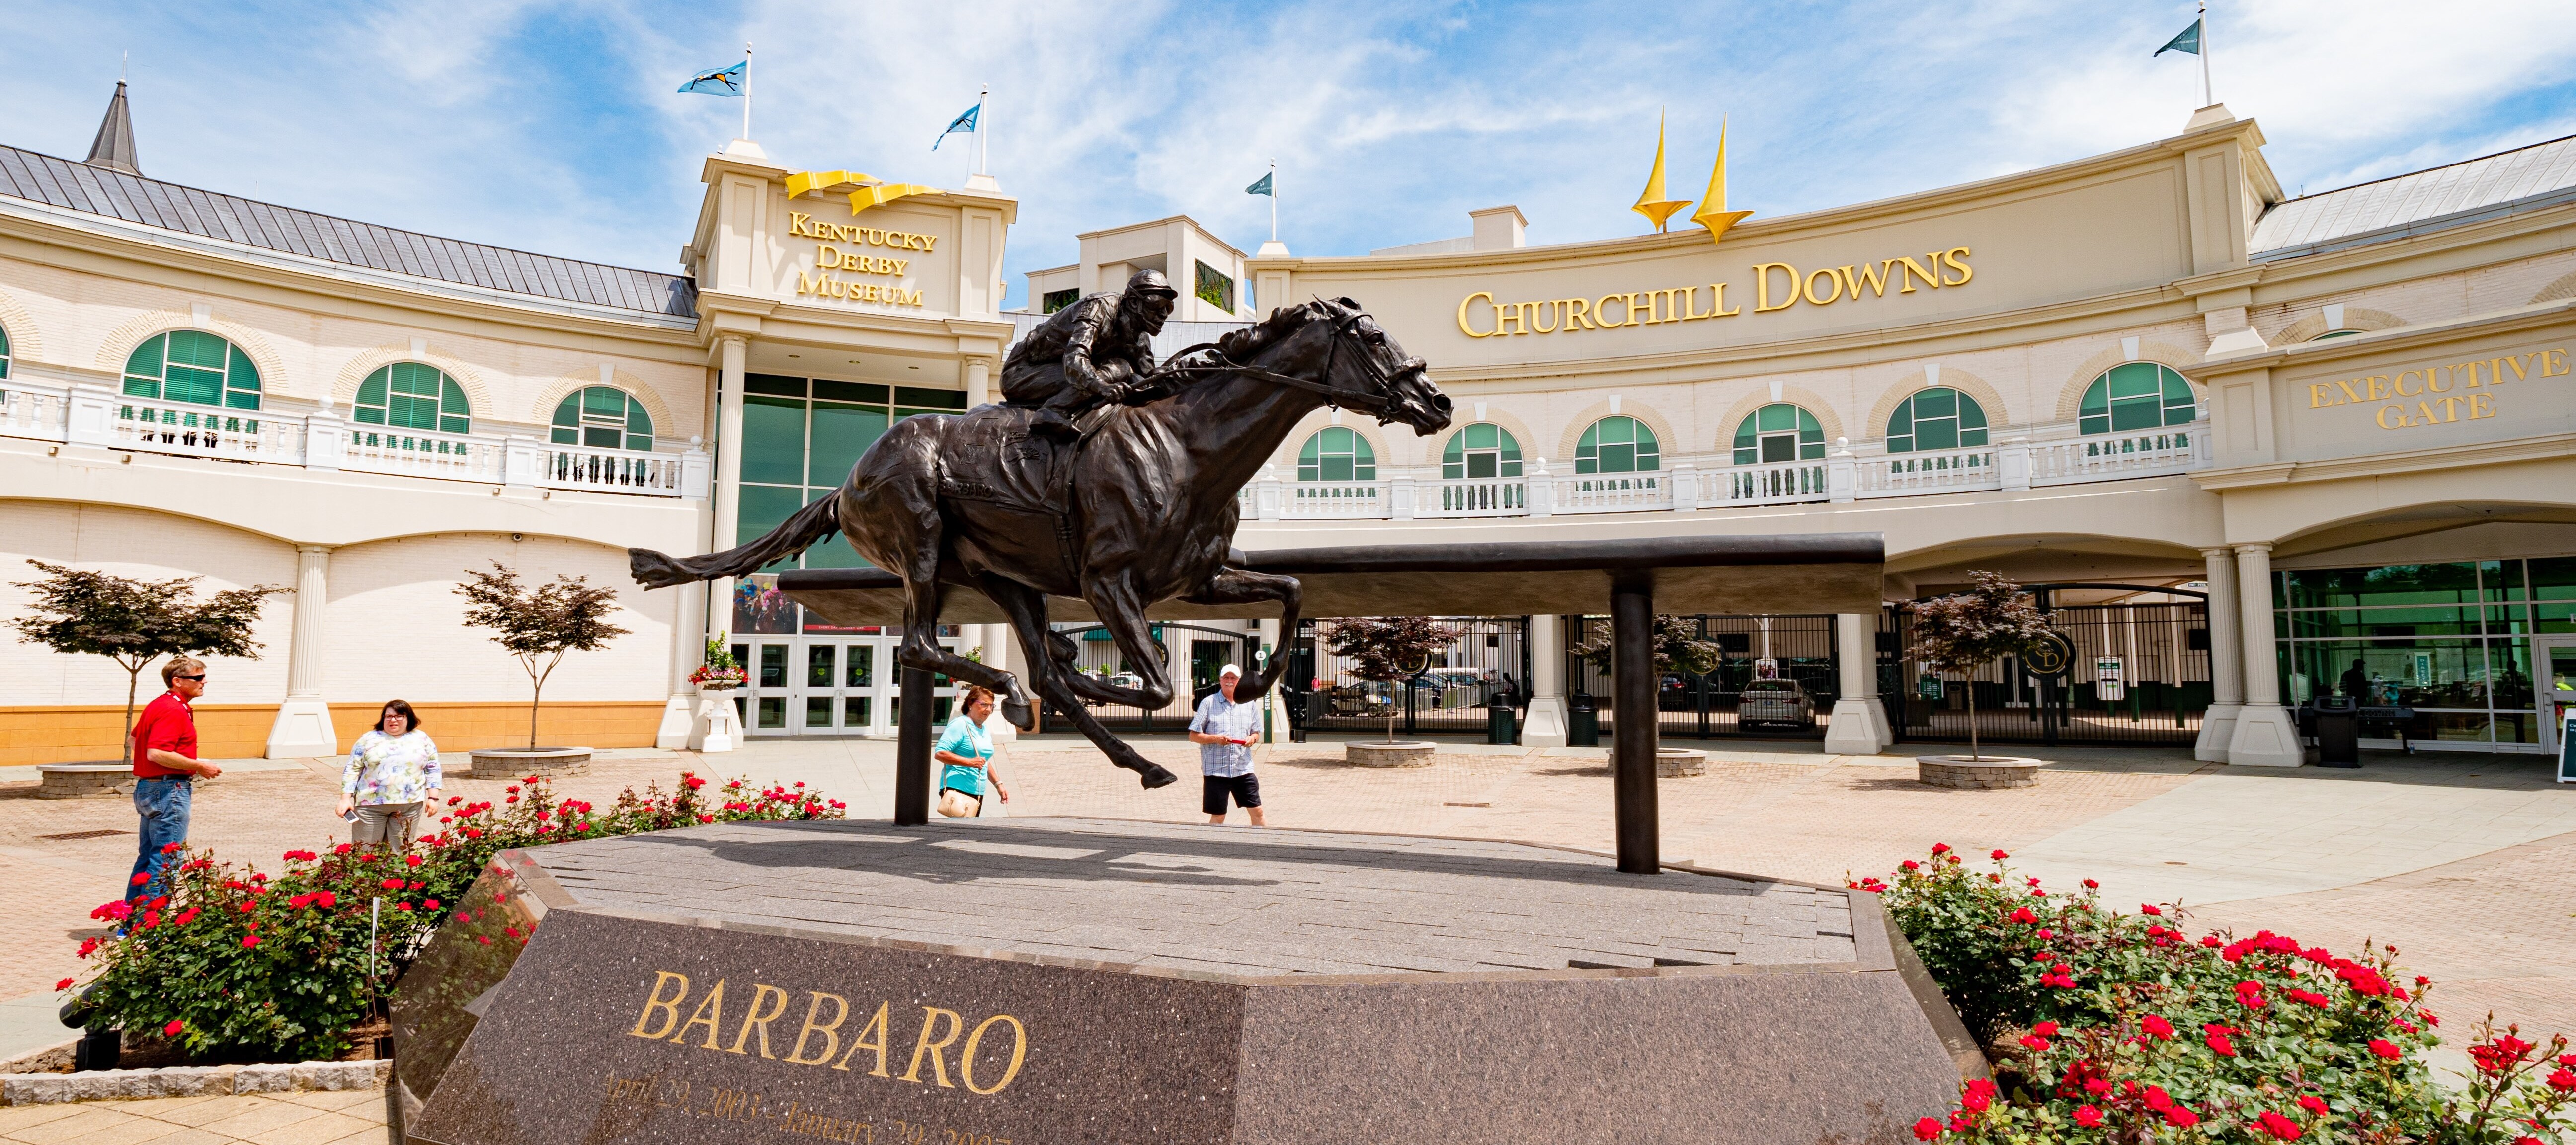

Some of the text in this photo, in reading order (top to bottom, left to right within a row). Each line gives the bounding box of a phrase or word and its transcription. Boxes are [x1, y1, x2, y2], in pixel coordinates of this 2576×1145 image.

[788, 210, 937, 252] KENTUCKY
[816, 244, 909, 276] DERBY
[798, 270, 923, 306] MUSEUM
[1457, 246, 1973, 338] CHURCHILL DOWNS
[2308, 348, 2571, 409] EXECUTIVE
[2376, 392, 2497, 430] GATE
[939, 480, 994, 497] BARBARO
[627, 970, 1027, 1094] BARBARO
[698, 1086, 761, 1122] 2003
